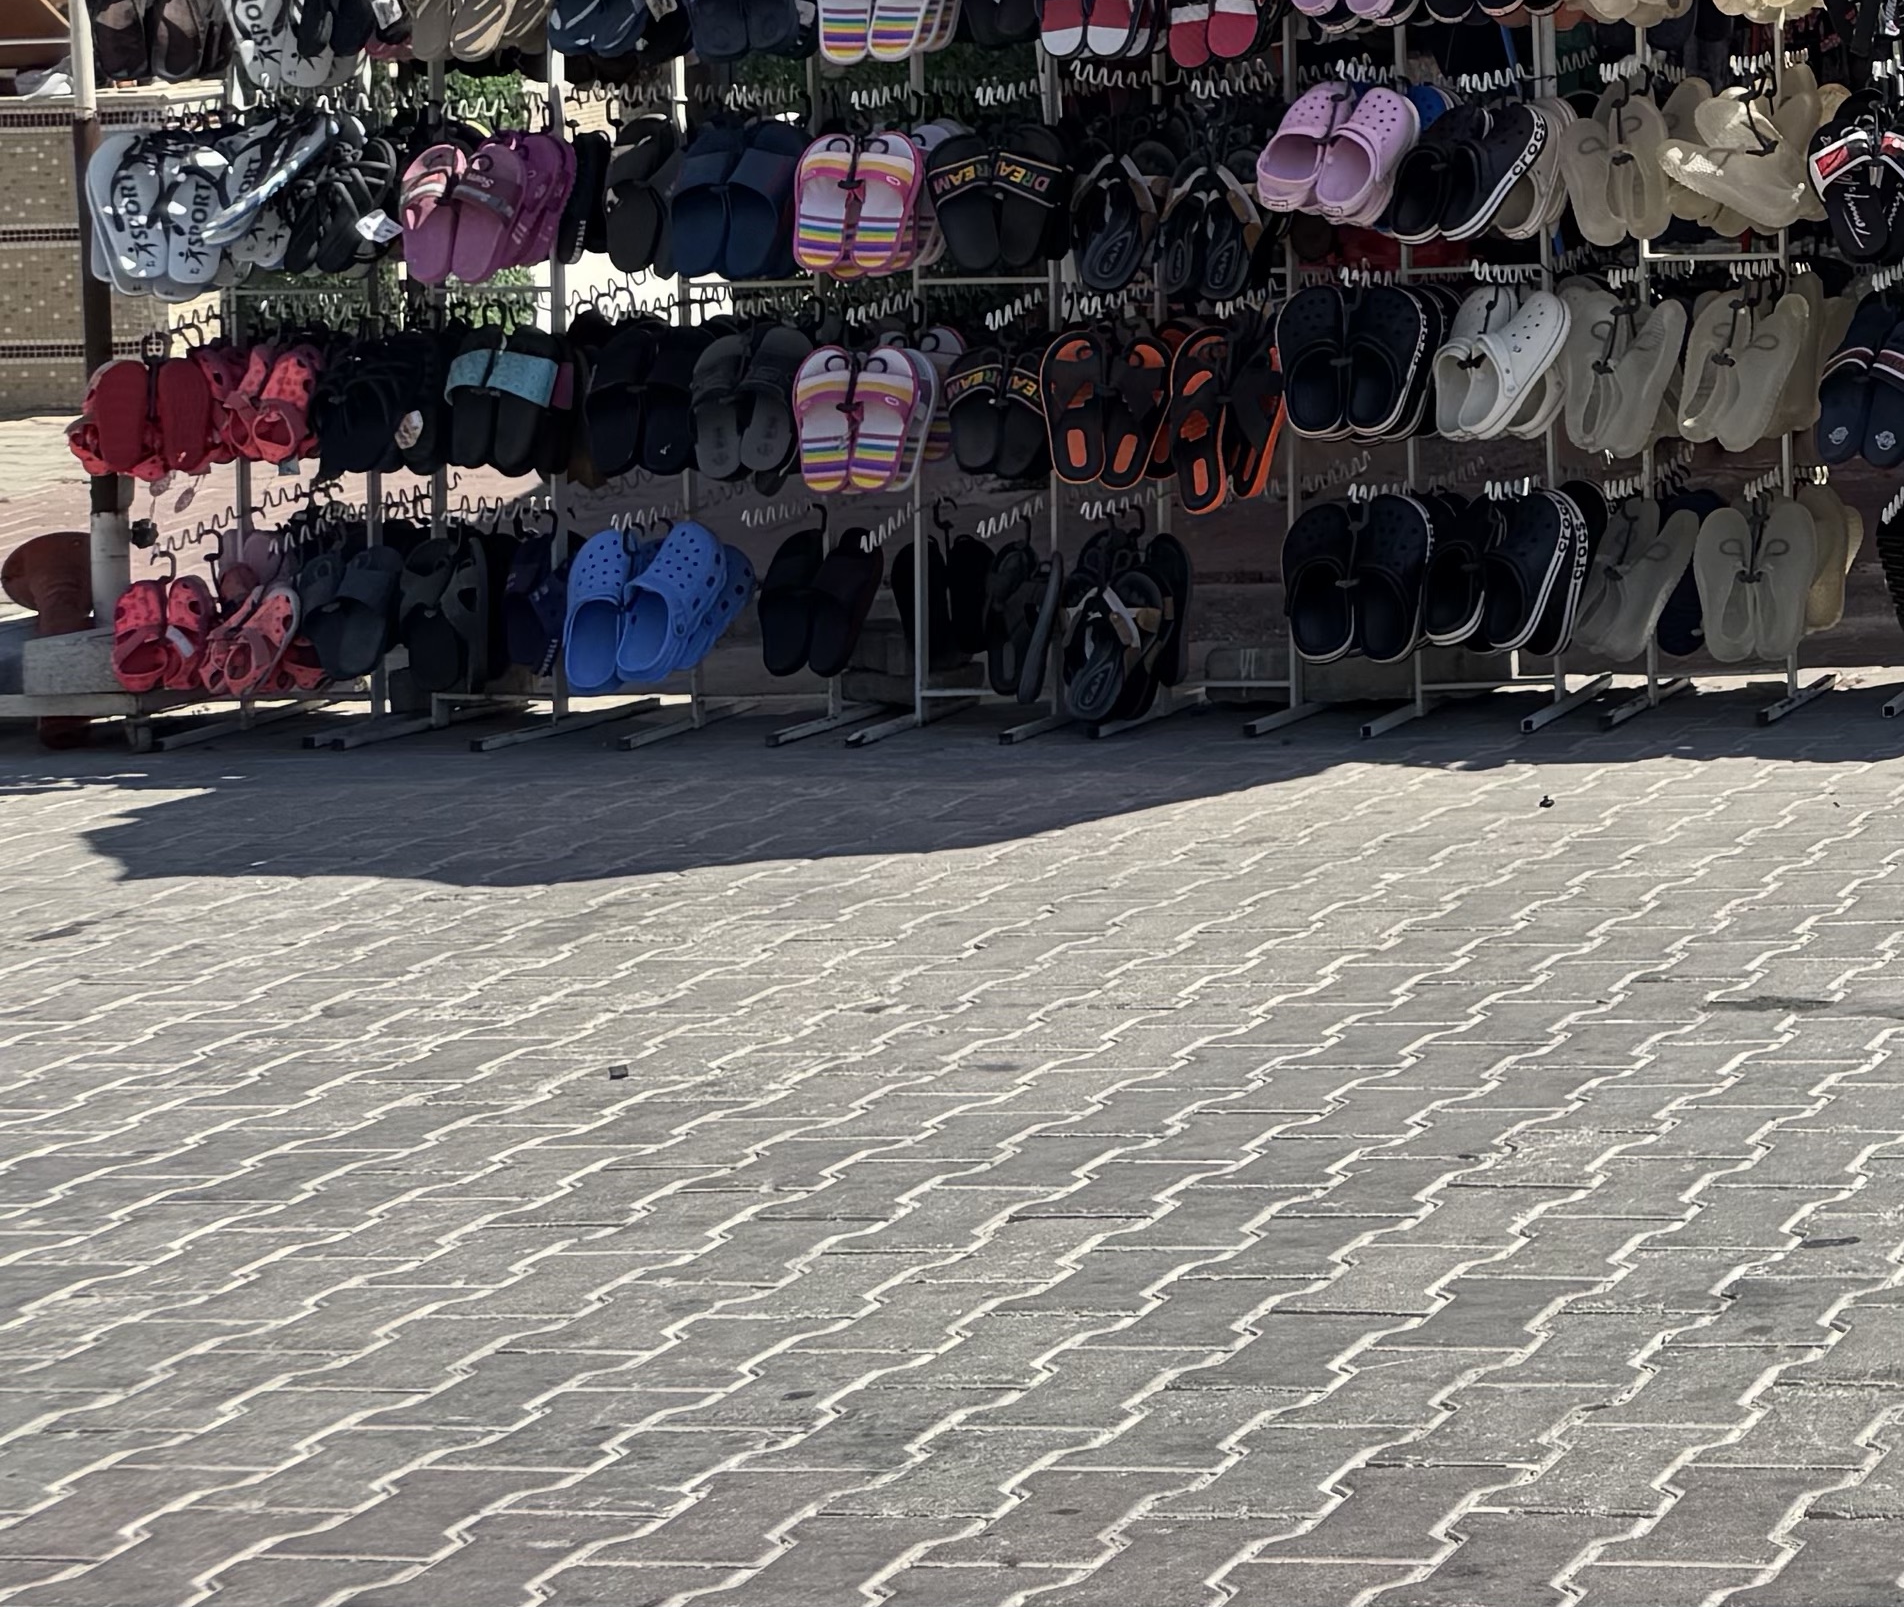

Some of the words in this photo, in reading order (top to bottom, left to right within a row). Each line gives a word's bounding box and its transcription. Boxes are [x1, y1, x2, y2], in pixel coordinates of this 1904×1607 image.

[996, 160, 1050, 193] DREA
[1511, 116, 1547, 178] crocs
[119, 172, 147, 240] SPORT
[934, 163, 990, 195] REAM
[187, 180, 213, 248] SPORT
[946, 368, 1000, 402] REAM
[1573, 521, 1589, 581] crocs
